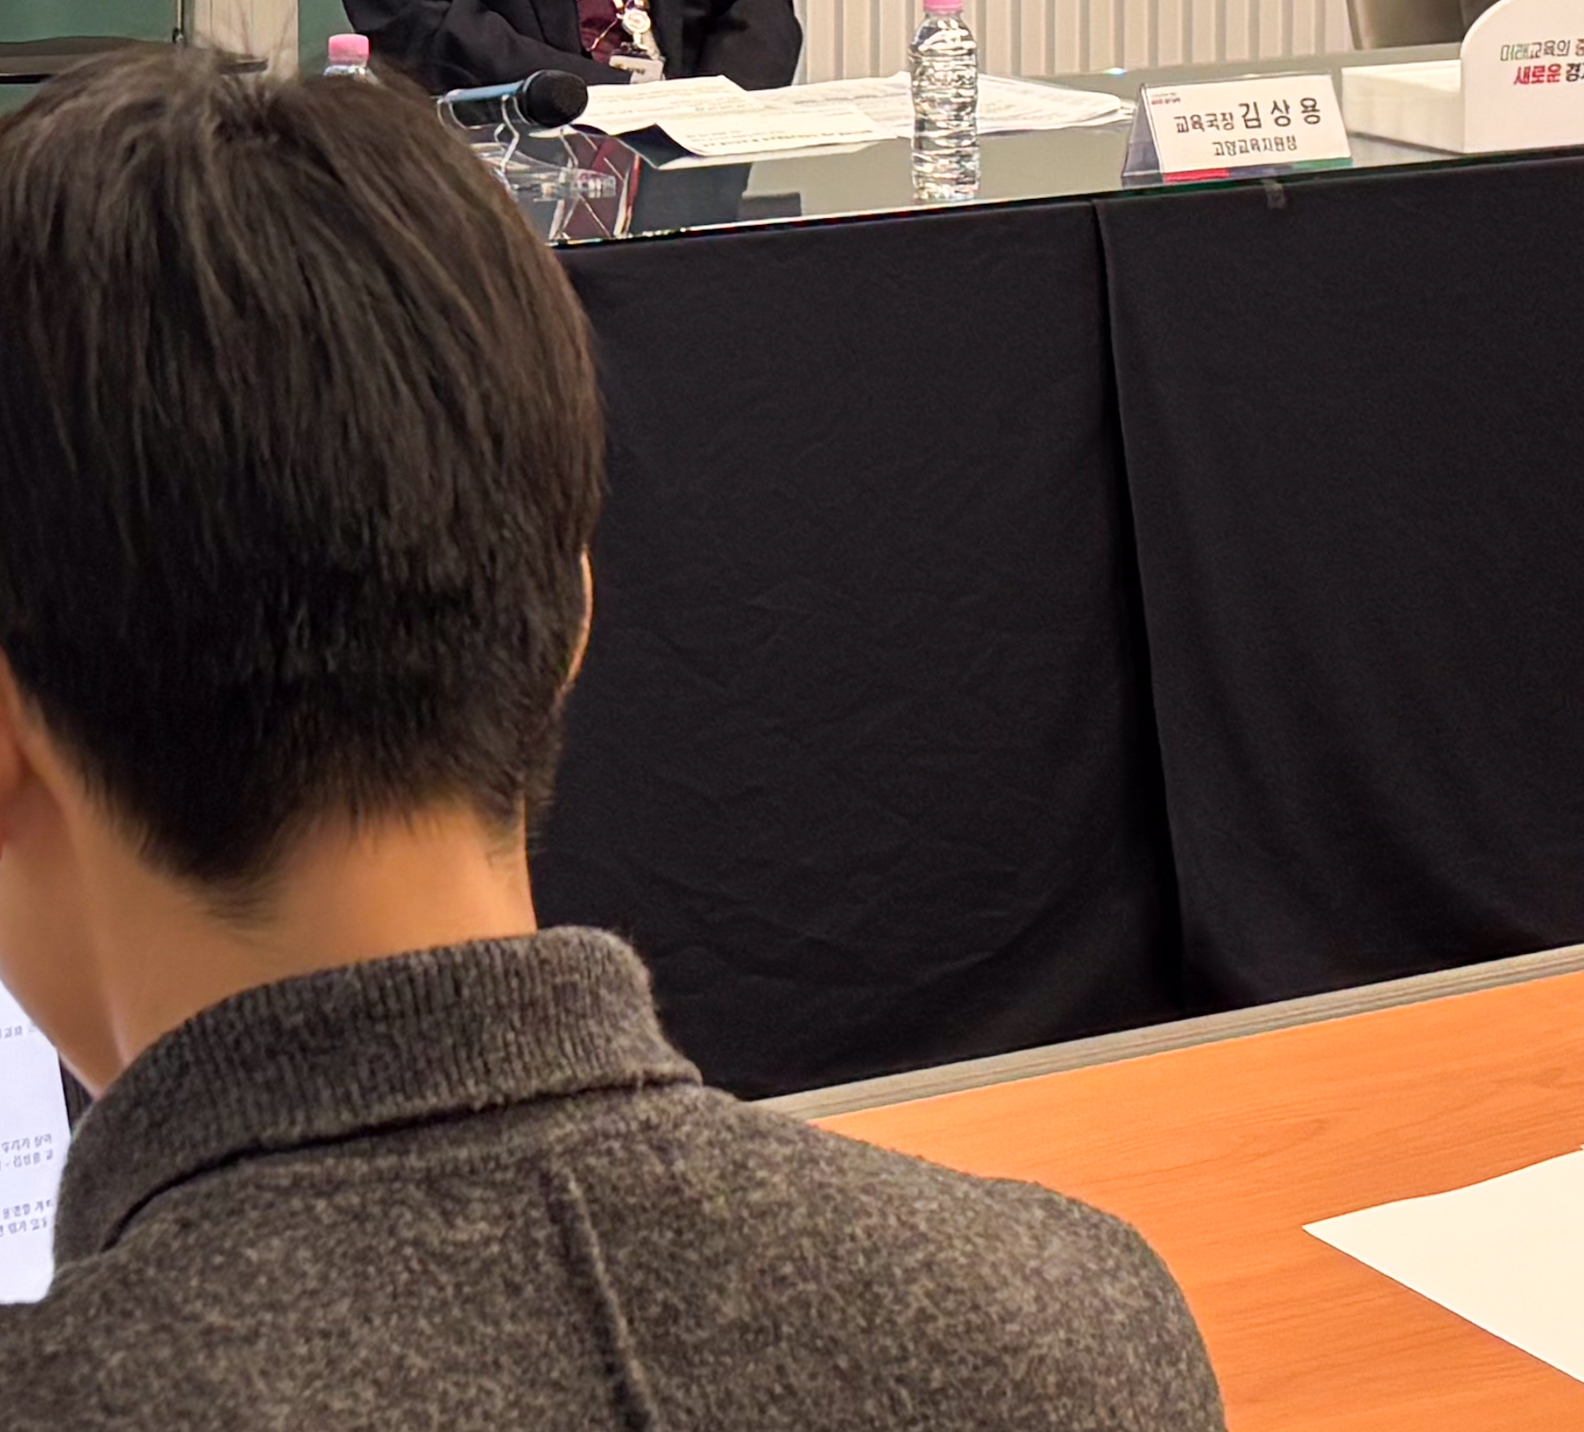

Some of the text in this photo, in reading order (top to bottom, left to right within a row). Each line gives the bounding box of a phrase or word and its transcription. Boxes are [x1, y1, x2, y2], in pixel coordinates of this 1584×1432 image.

[1500, 40, 1572, 61] 미래교육의
[1513, 63, 1562, 86] 새로운
[1173, 112, 1235, 133] 교육국장
